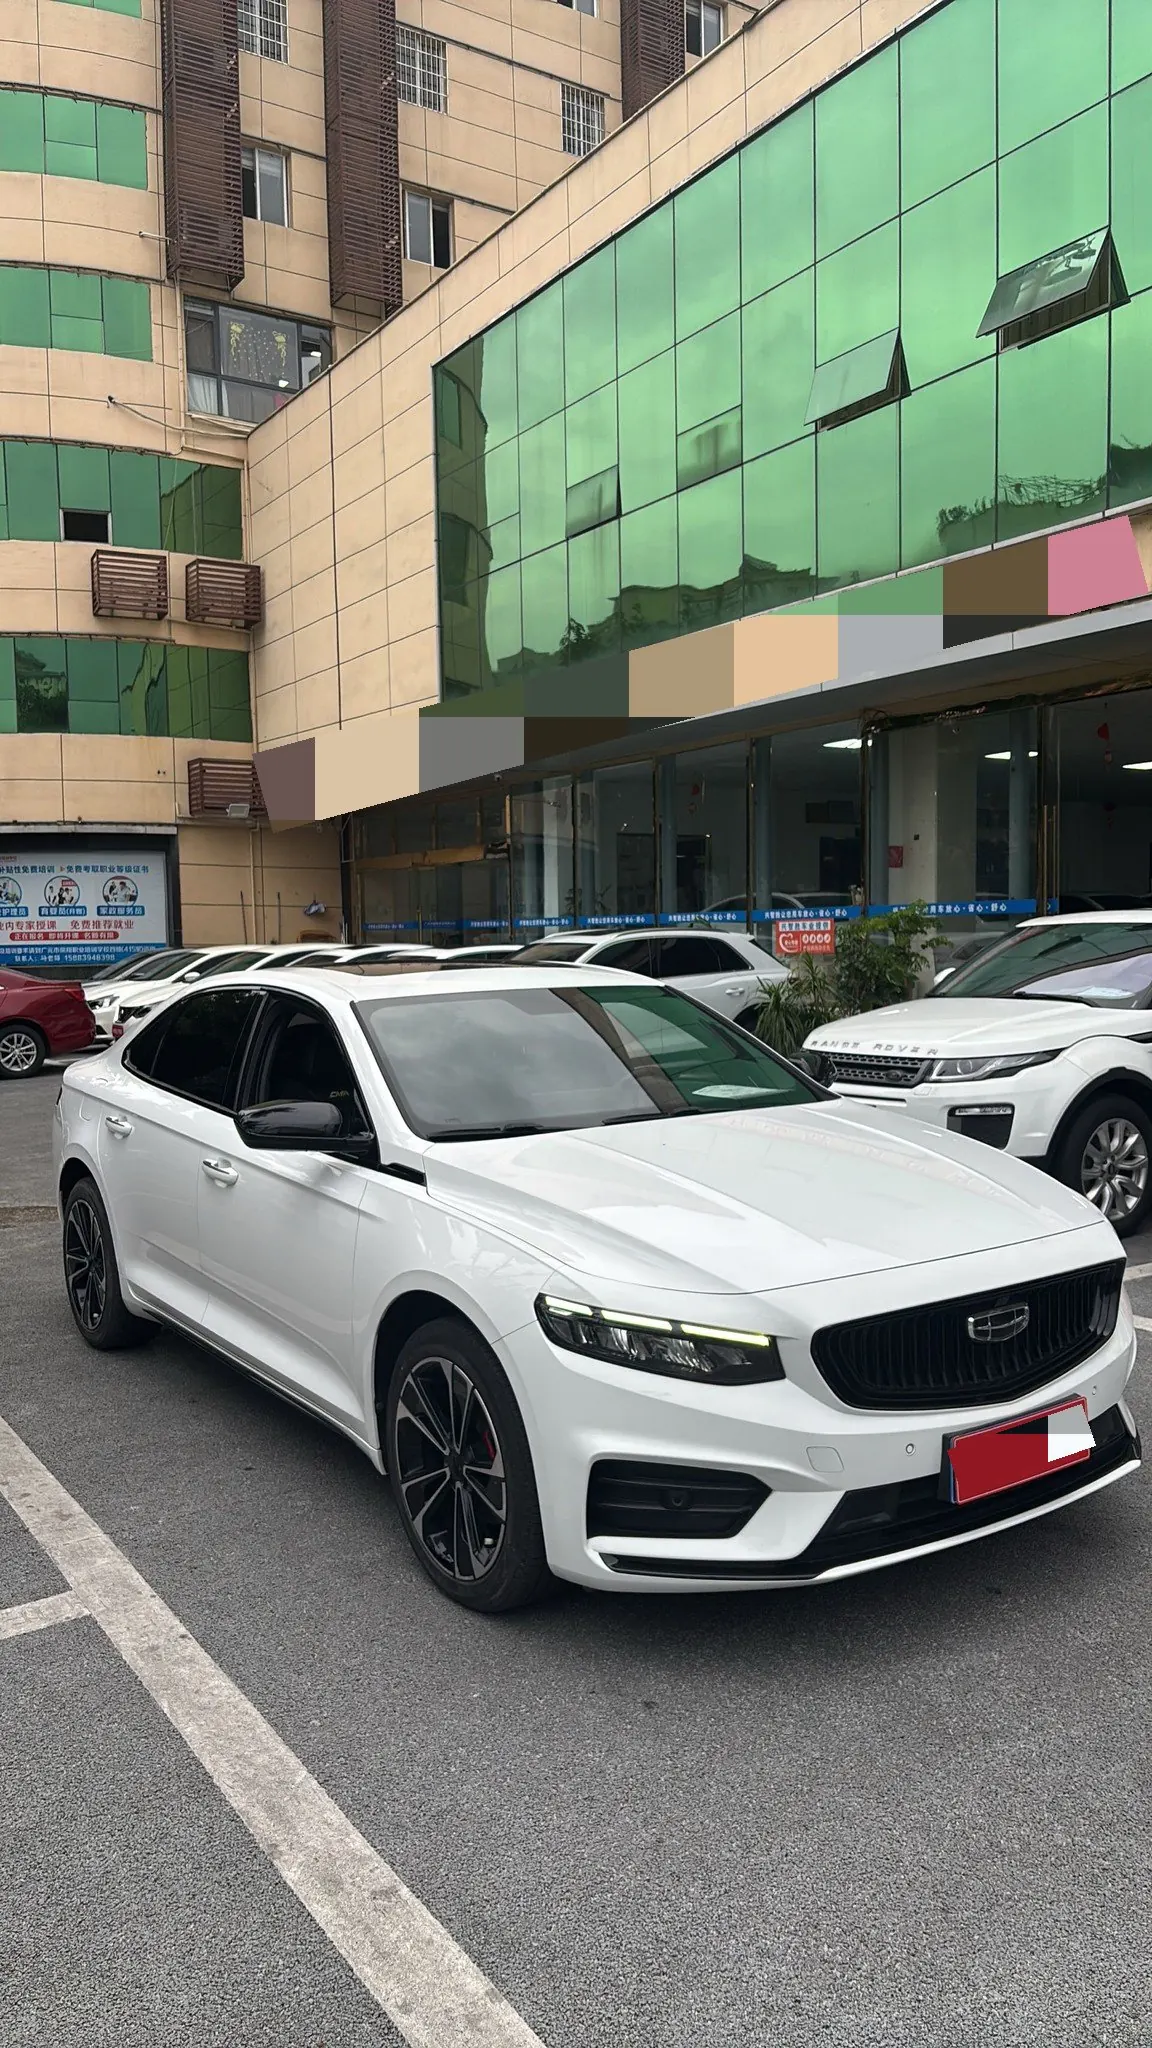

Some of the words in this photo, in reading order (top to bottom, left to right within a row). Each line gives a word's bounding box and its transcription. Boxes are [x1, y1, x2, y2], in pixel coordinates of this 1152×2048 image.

[0, 908, 26, 916] 护理员
[99, 907, 143, 915] 家政服务员
[70, 920, 134, 930] 免费推荐就业
[810, 1040, 861, 1049] RANGE
[873, 1043, 939, 1056] ROVER
